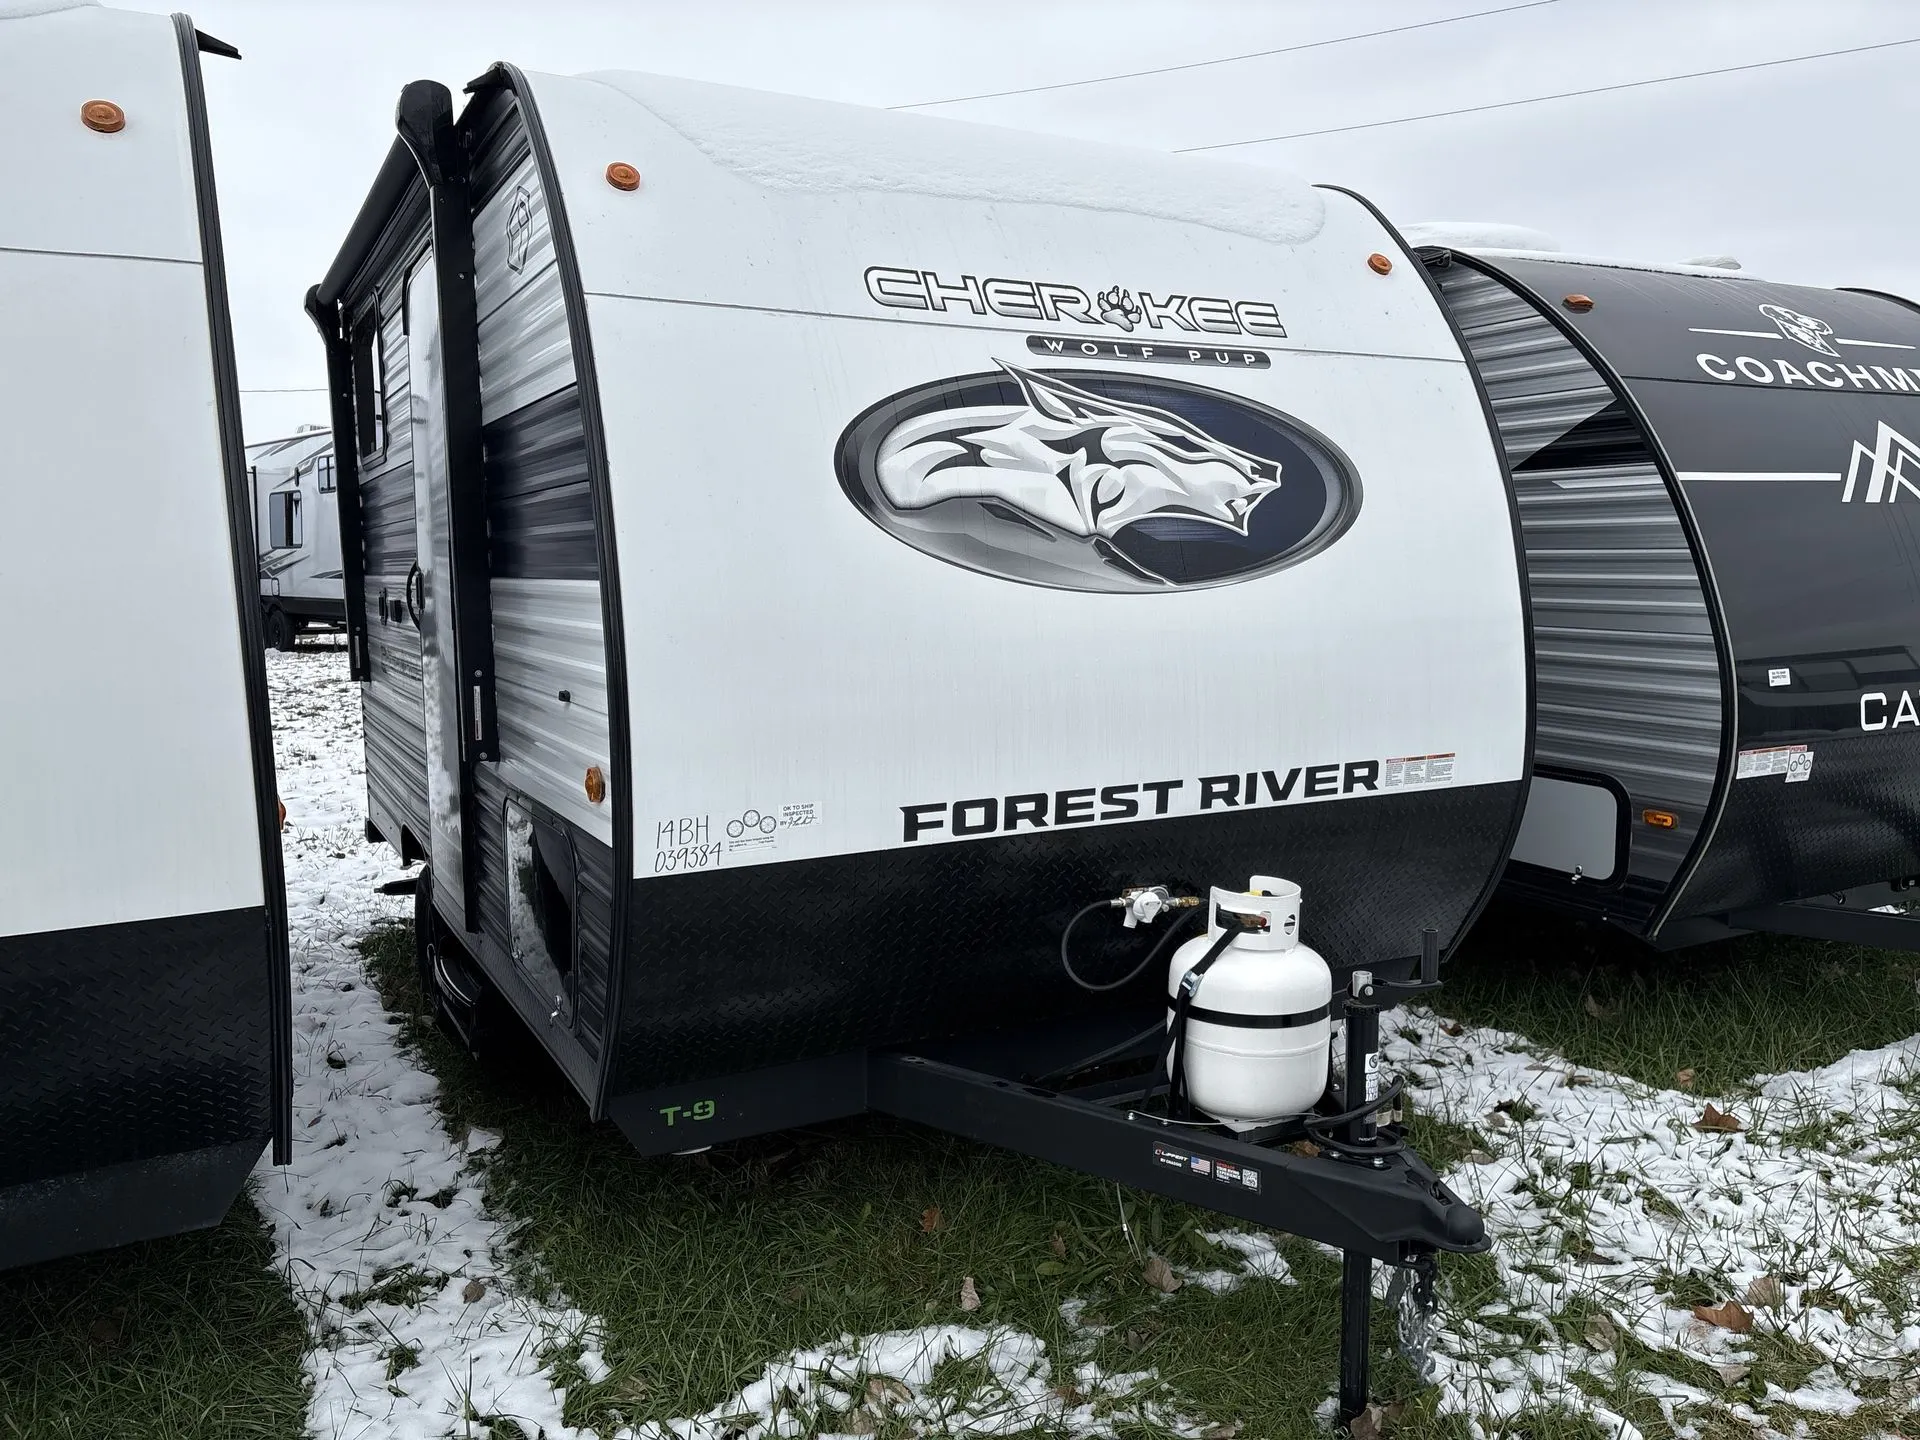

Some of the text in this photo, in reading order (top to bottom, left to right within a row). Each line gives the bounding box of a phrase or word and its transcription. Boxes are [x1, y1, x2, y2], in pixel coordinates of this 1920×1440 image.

[1042, 338, 1256, 366] WOLF PUP
[1860, 690, 1920, 732] CA
[783, 809, 814, 817] INSPECTED
[898, 779, 1183, 842] FOREST
[1197, 759, 1380, 810] RIVER
[654, 841, 722, 873] 039384
[659, 1100, 716, 1126] T-9
